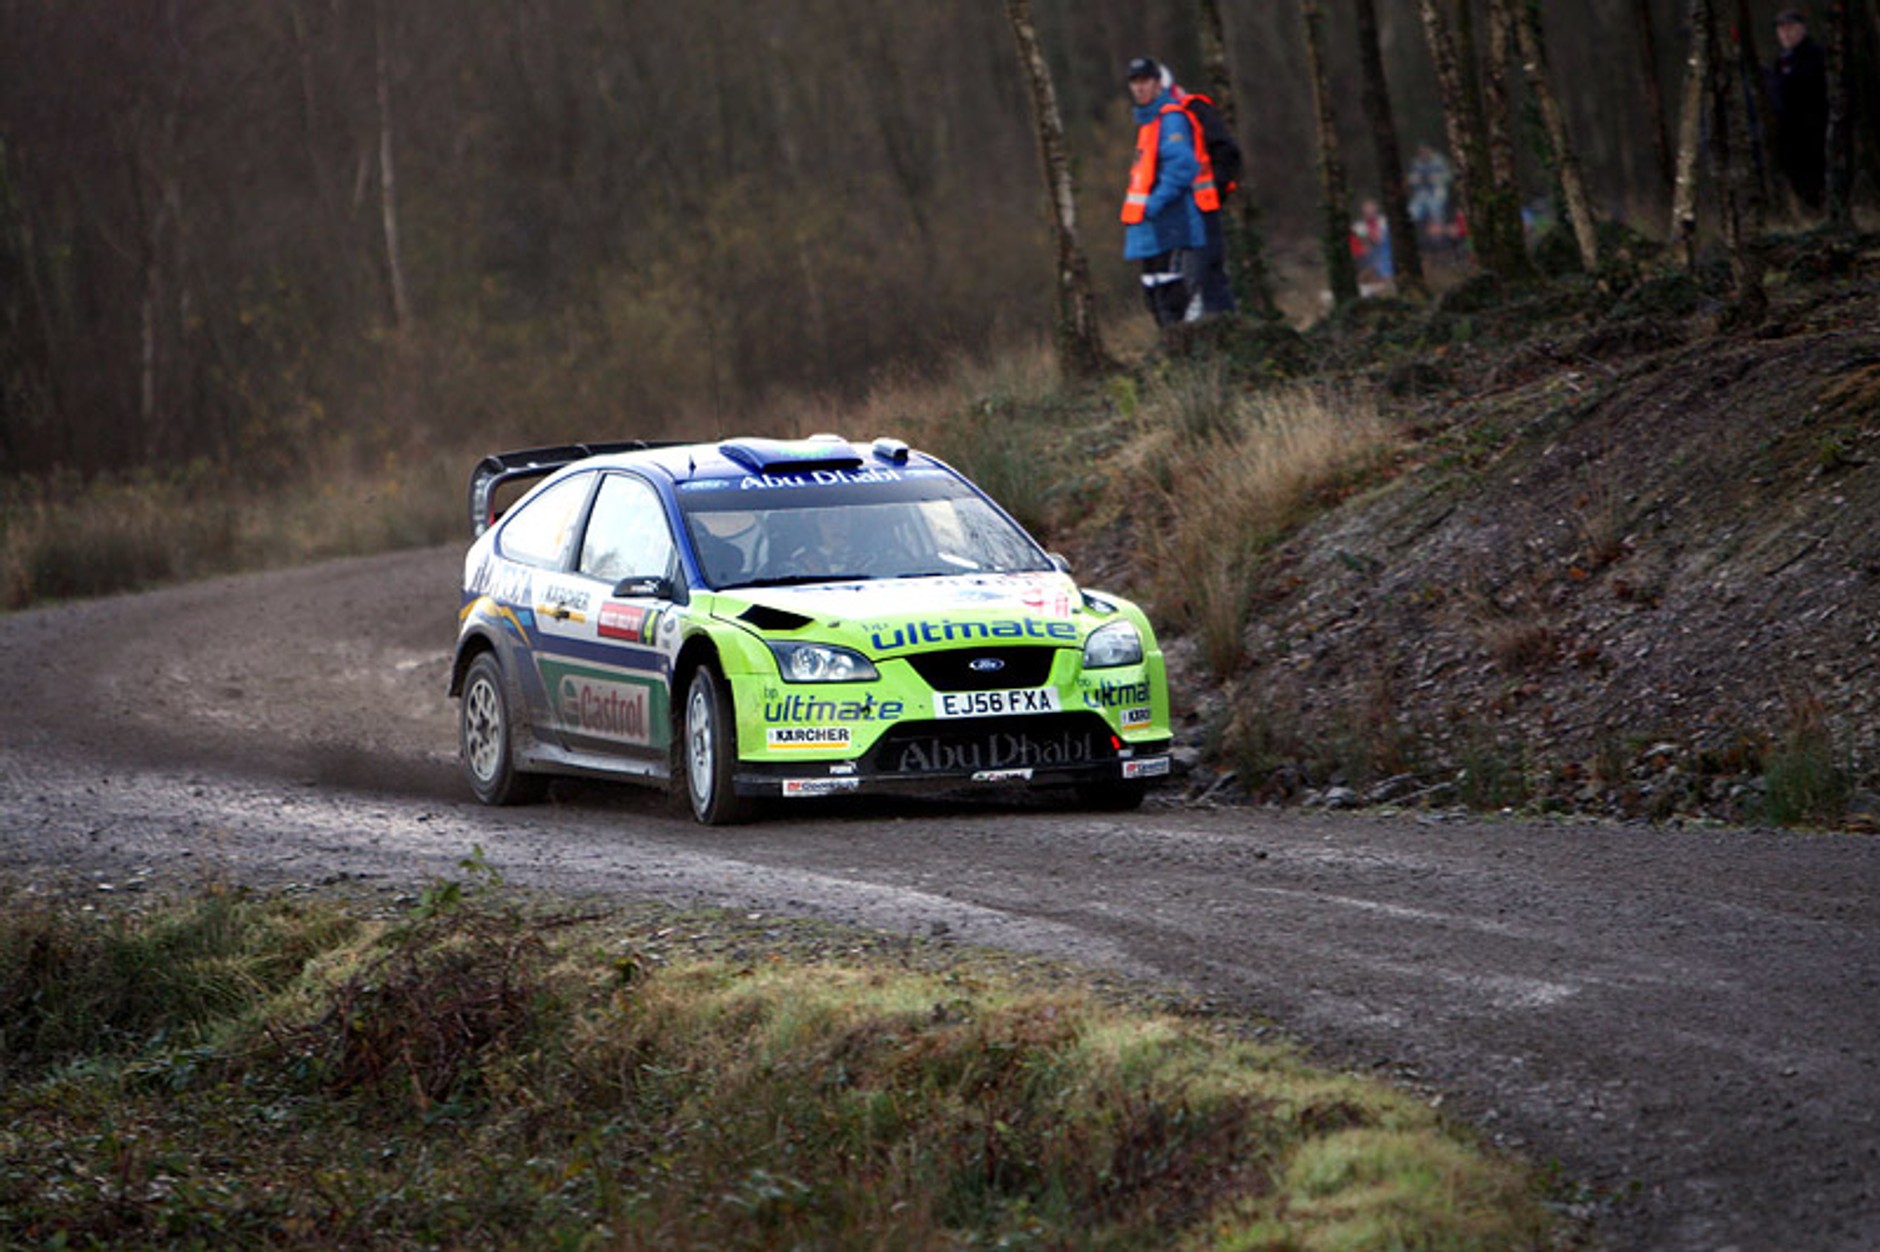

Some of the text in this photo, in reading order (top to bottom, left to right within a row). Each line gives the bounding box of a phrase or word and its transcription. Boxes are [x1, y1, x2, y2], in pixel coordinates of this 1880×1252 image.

[740, 472, 805, 489] Abu
[872, 617, 1077, 650] ultimate
[581, 684, 645, 738] Castrol
[764, 691, 904, 722] ultimate
[1008, 690, 1052, 711] FXA
[899, 731, 1092, 771] Abu Dhabi
